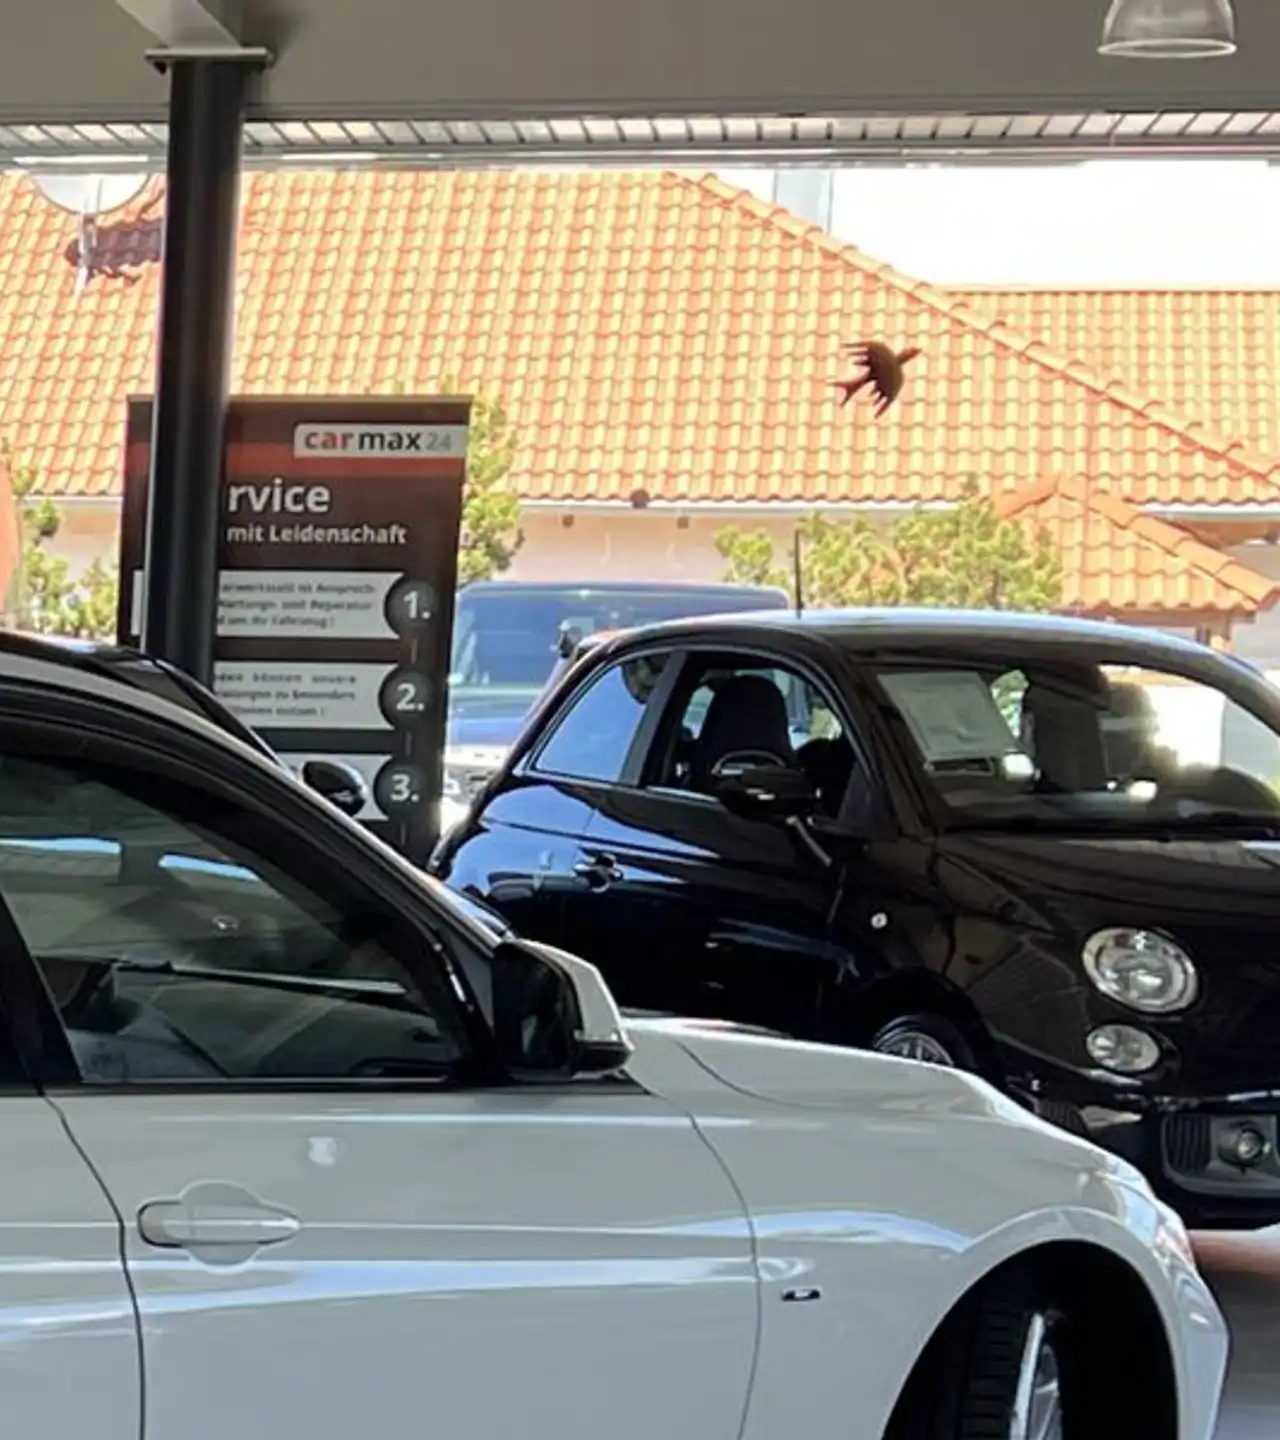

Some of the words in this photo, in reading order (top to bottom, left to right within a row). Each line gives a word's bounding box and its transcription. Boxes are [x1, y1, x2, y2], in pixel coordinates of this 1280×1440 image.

[227, 477, 331, 513] rvice
[227, 524, 264, 542] mit
[269, 523, 406, 544] Leidenschaft
[402, 590, 432, 619] 1.
[396, 684, 426, 712] 2.
[390, 773, 421, 803] 3.
